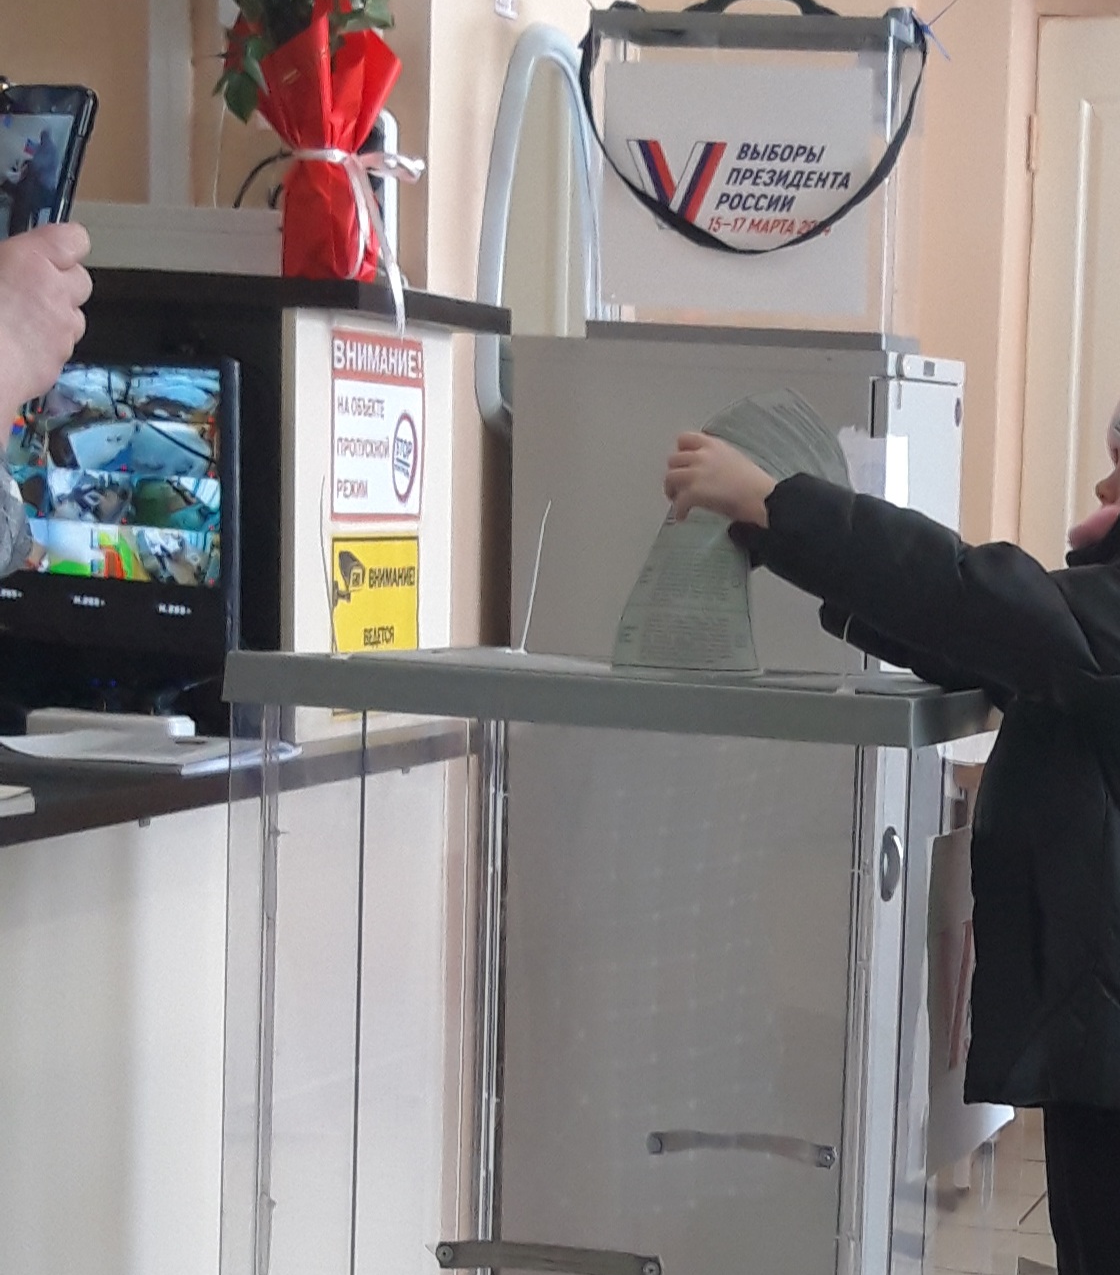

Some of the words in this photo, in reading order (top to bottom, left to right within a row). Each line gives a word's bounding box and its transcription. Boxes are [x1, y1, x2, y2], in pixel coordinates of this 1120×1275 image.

[736, 142, 825, 164] ВЫБОРЫ
[725, 168, 851, 190] ПРЕЗИДЕНТА
[715, 192, 796, 212] РОССИИ
[749, 218, 795, 236] МАРТА
[333, 339, 424, 379] ВНИМАНИЕ!
[337, 396, 350, 416] НА
[351, 398, 385, 420] ОБЪЕКТЕ
[336, 436, 390, 460] ПРОПУСКНОЙ
[336, 478, 369, 500] РЕЖИМ
[363, 626, 395, 648] ВЕДЕТСЯ
